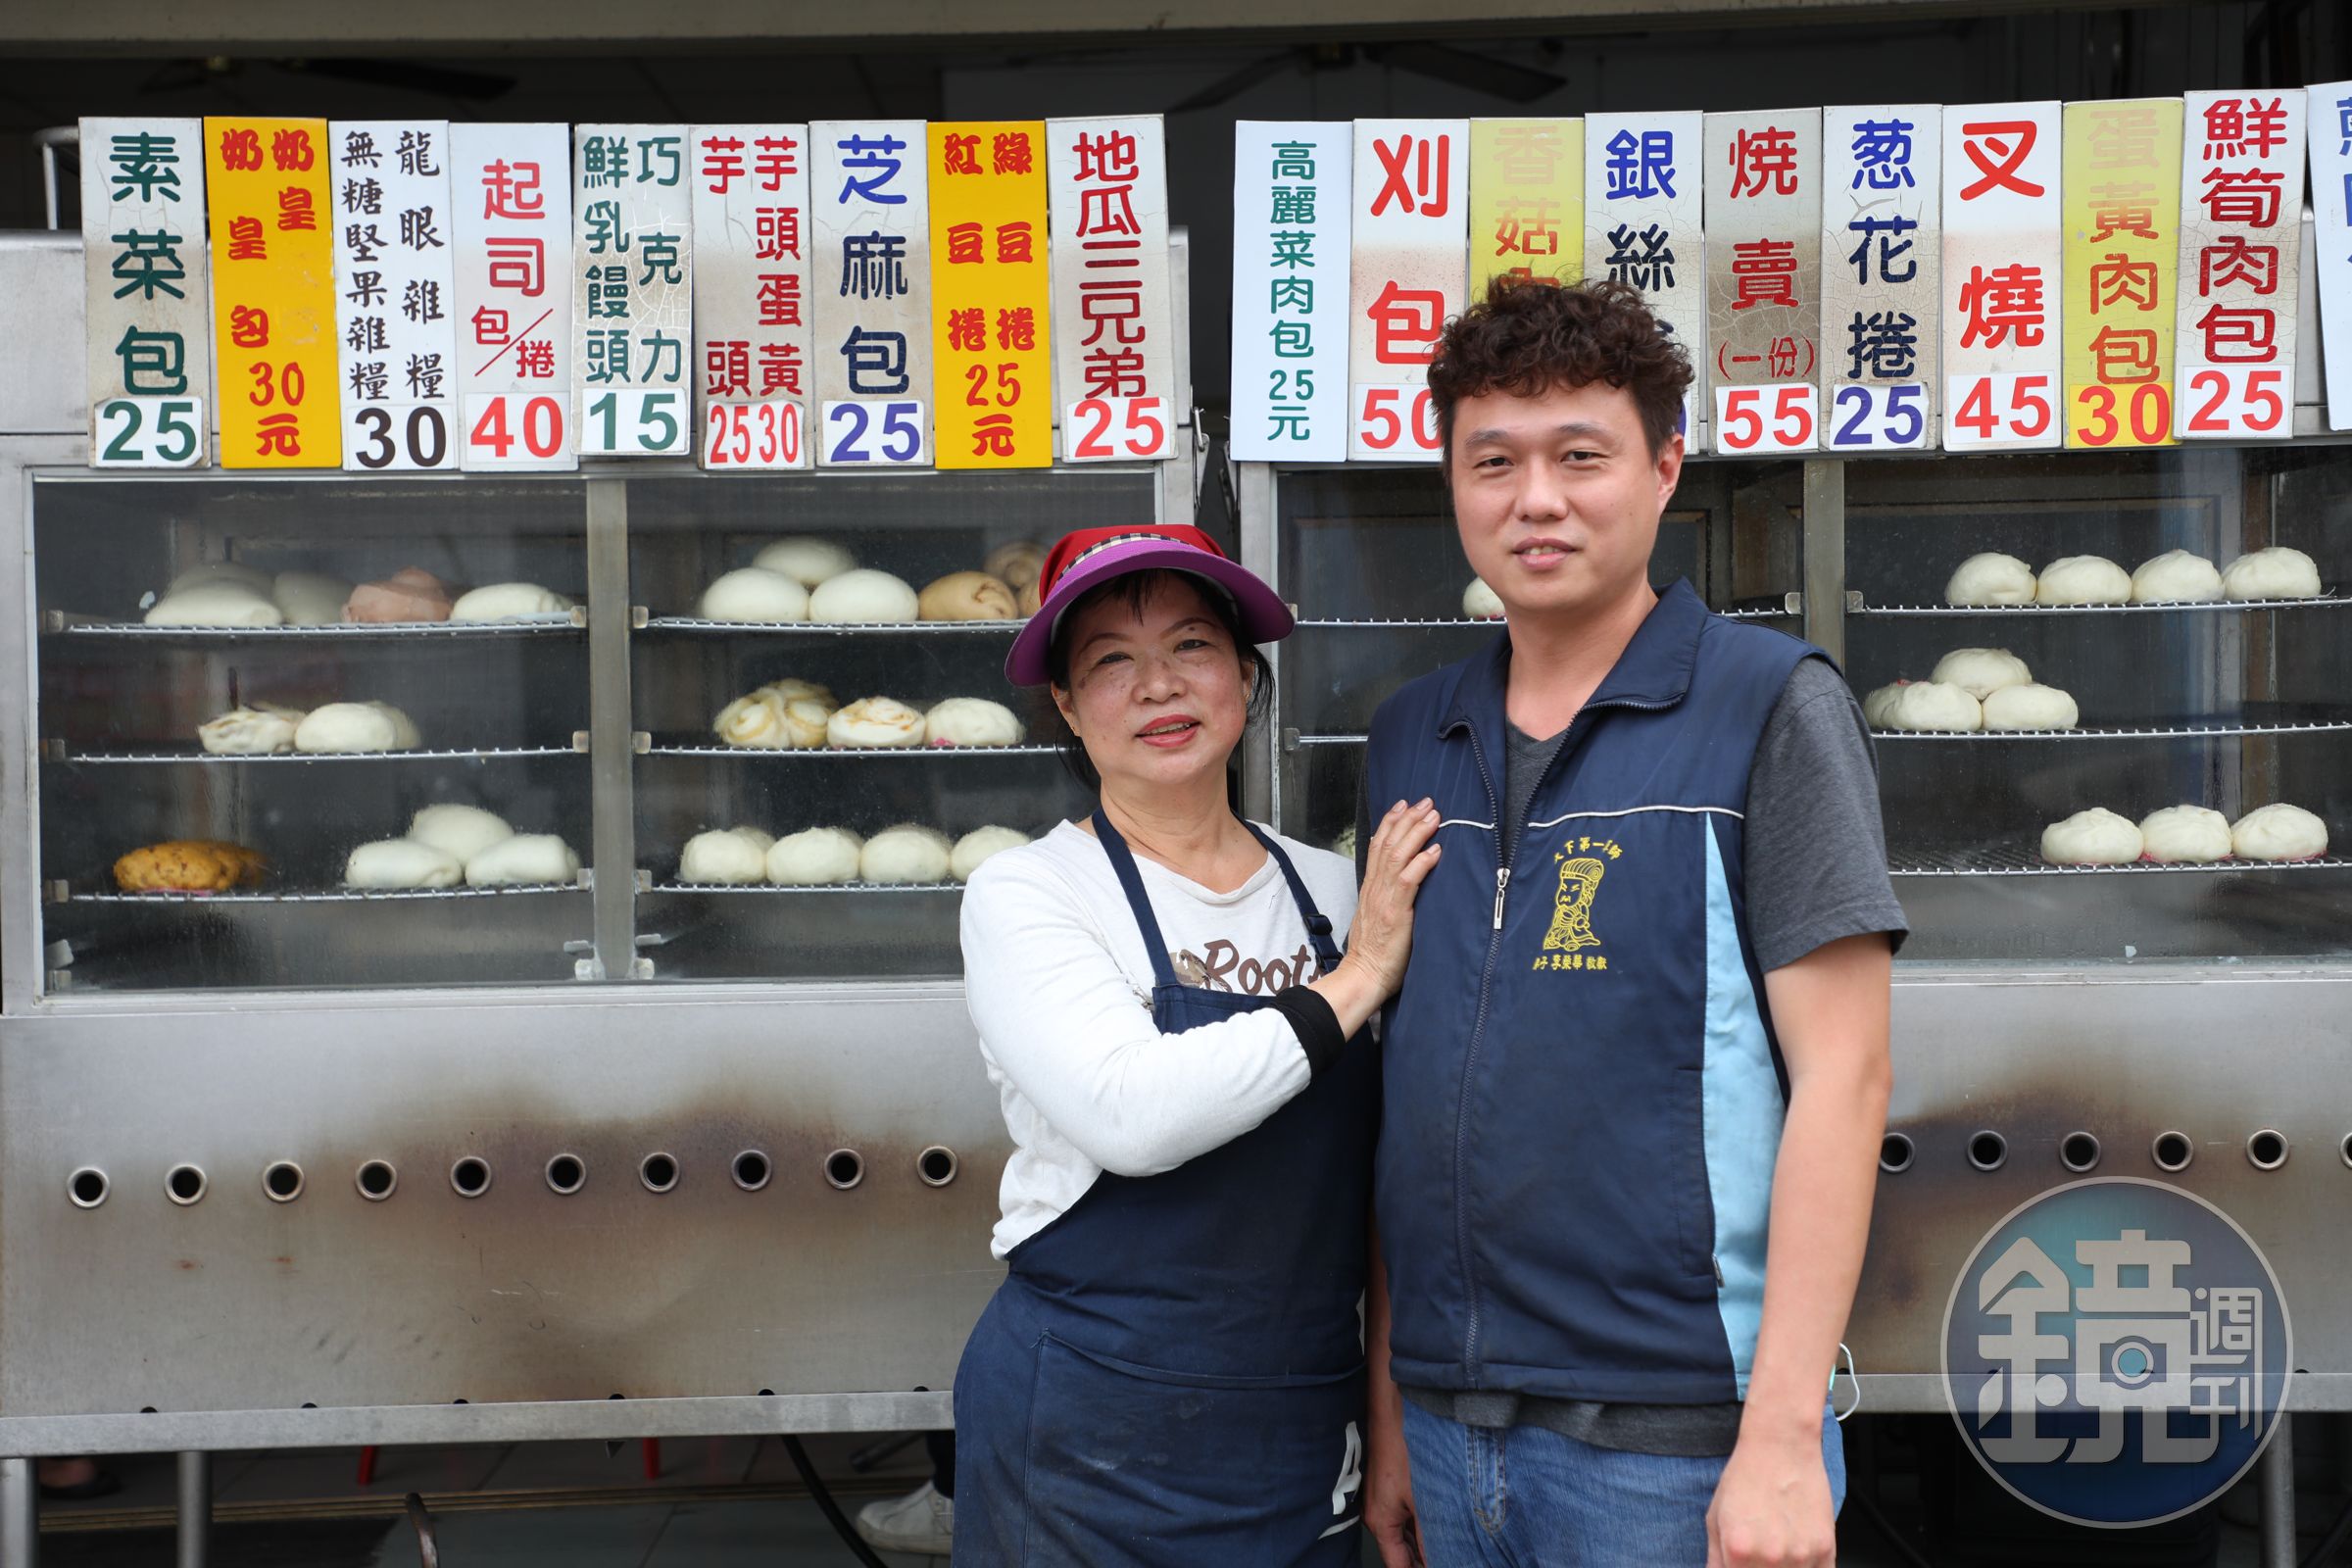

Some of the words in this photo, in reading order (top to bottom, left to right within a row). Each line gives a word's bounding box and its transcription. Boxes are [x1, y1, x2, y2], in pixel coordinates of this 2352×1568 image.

[110, 131, 187, 395] 素菜包
[340, 130, 391, 401] 無糖堅果雜糧
[395, 130, 446, 400] 龍眼雜糧
[482, 158, 545, 298] 起司
[583, 136, 631, 383] 鮮乳饅頭
[636, 136, 682, 383] 巧克力
[837, 133, 909, 394] 芝麻包
[944, 132, 987, 352] 紅豆捲
[1073, 130, 1147, 397] 地瓜三兄弟
[1367, 133, 1450, 365] 刈包
[1493, 125, 1565, 288] 香菇
[1605, 129, 1678, 336] 銀絲
[1959, 121, 2045, 349] 叉燒
[2087, 109, 2161, 385] 蛋黃肉包
[2196, 97, 2288, 364] 鮮筍肉包
[102, 402, 197, 462] 25
[355, 407, 446, 468] 30
[470, 396, 564, 458] 40
[590, 392, 678, 451] 15
[830, 403, 920, 462] 25
[1074, 397, 1165, 458] 25
[1361, 388, 1444, 450] 50
[1723, 387, 1812, 449] 55
[1834, 385, 1923, 446] 25
[1954, 375, 2051, 438] 45
[2078, 384, 2171, 447] 30
[2187, 369, 2284, 432] 25
